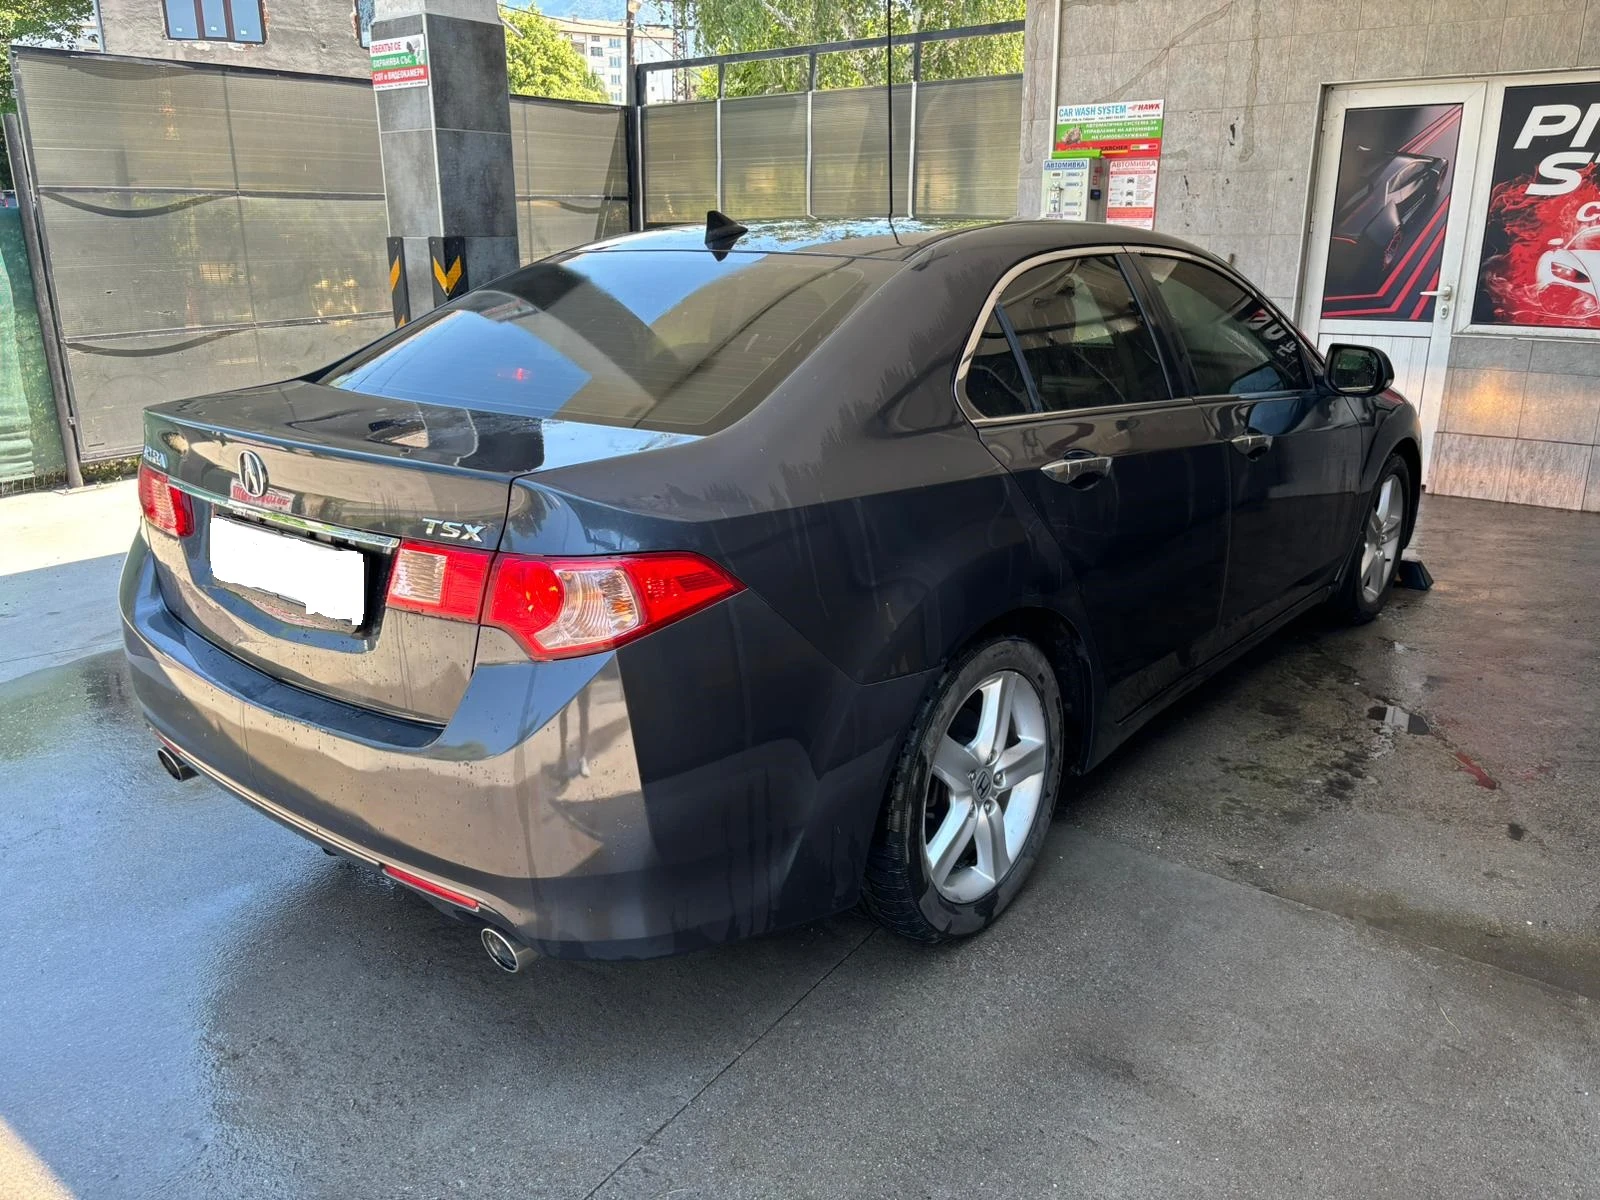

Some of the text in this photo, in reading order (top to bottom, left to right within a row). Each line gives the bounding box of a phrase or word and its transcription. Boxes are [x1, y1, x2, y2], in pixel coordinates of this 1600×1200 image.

[1059, 107, 1074, 118] CAR
[1075, 106, 1096, 117] WASH
[1098, 105, 1126, 115] SYSTEM
[1138, 103, 1160, 111] HAWK
[1046, 161, 1085, 169] АВТОМИВКА
[1111, 160, 1156, 169] АВТОМИВКА
[1525, 151, 1600, 195] S
[422, 518, 486, 543] TSX
